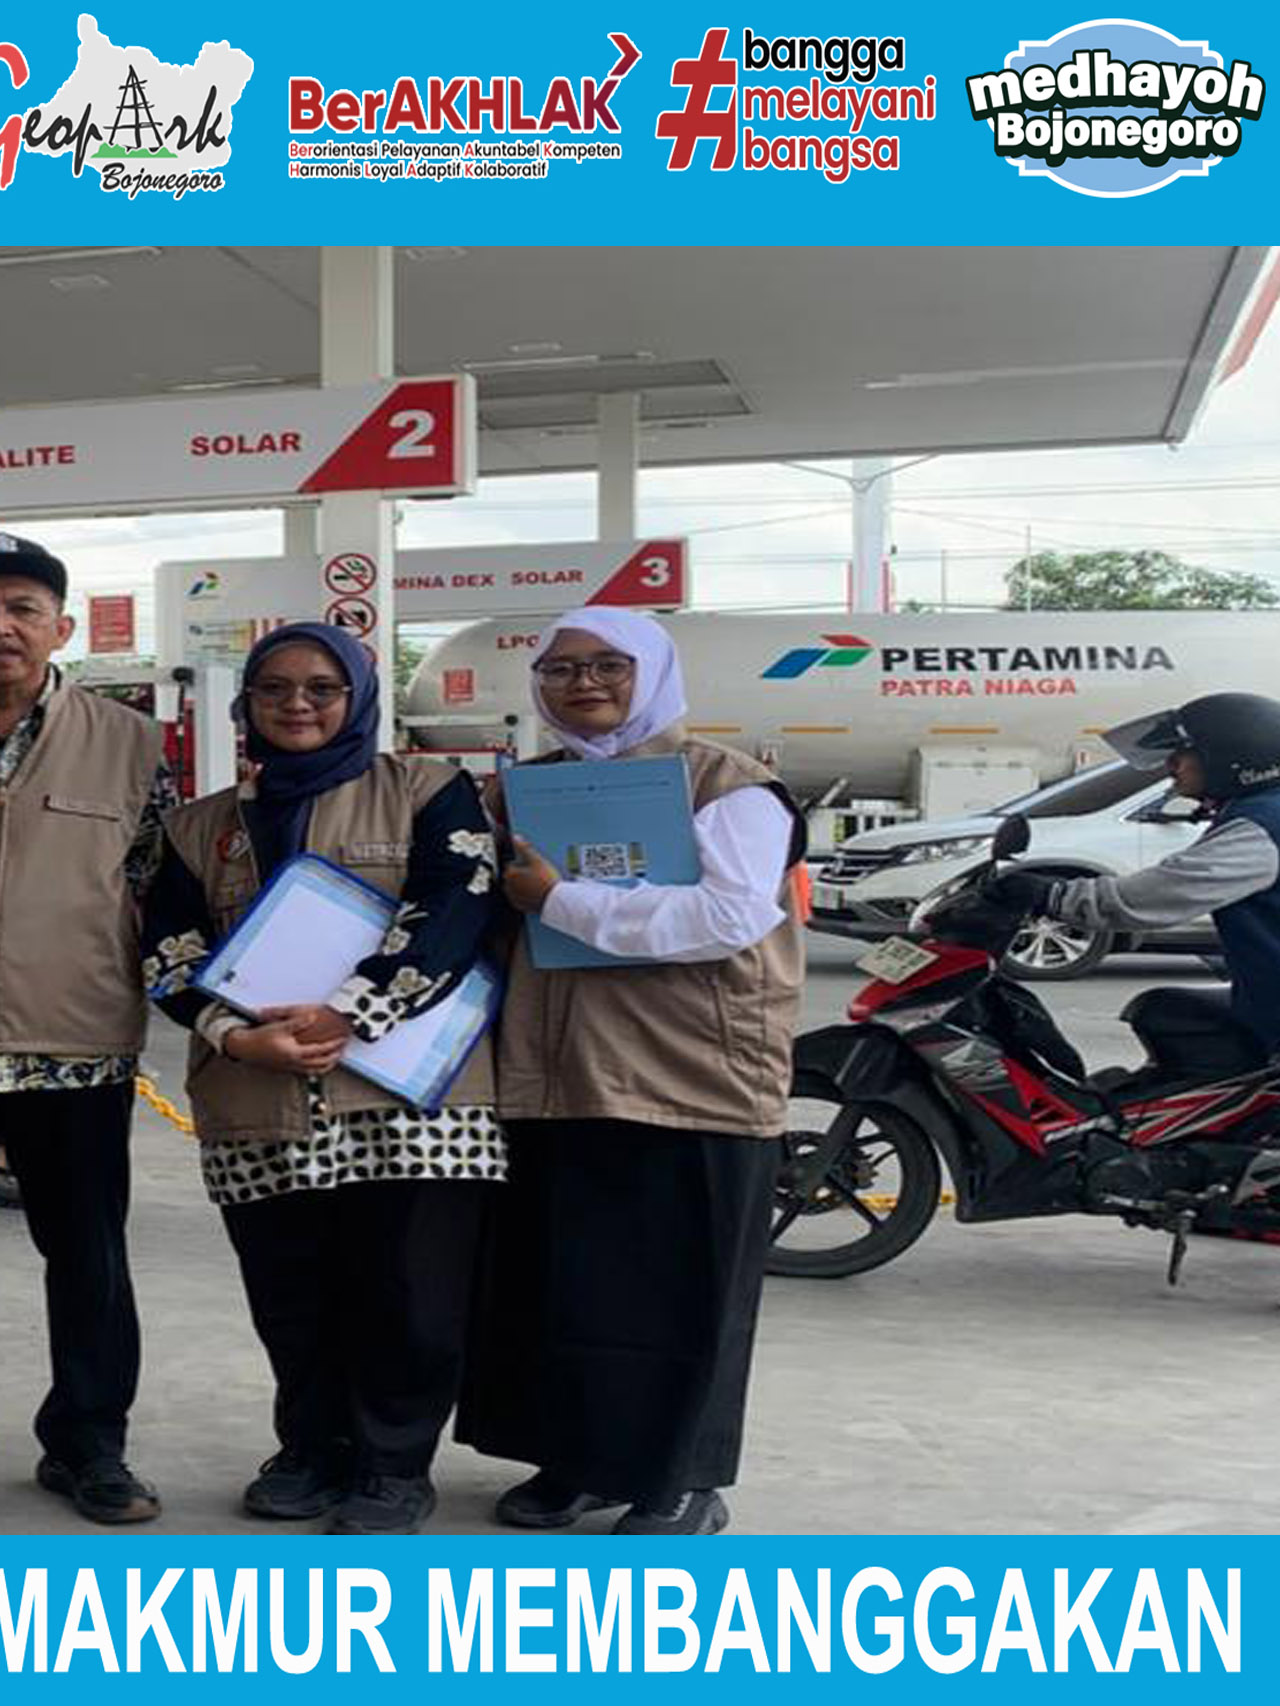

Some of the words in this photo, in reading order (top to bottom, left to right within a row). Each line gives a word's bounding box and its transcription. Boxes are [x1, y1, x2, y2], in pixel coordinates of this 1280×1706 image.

[190, 432, 302, 456] SOLAR
[387, 409, 435, 459] 2
[451, 573, 495, 588] DEX
[511, 570, 584, 586] SOLAR
[640, 557, 670, 587] 3
[881, 646, 1175, 672] PERTAMINA
[881, 679, 974, 697] PATRA
[985, 678, 1077, 695] NIAGA
